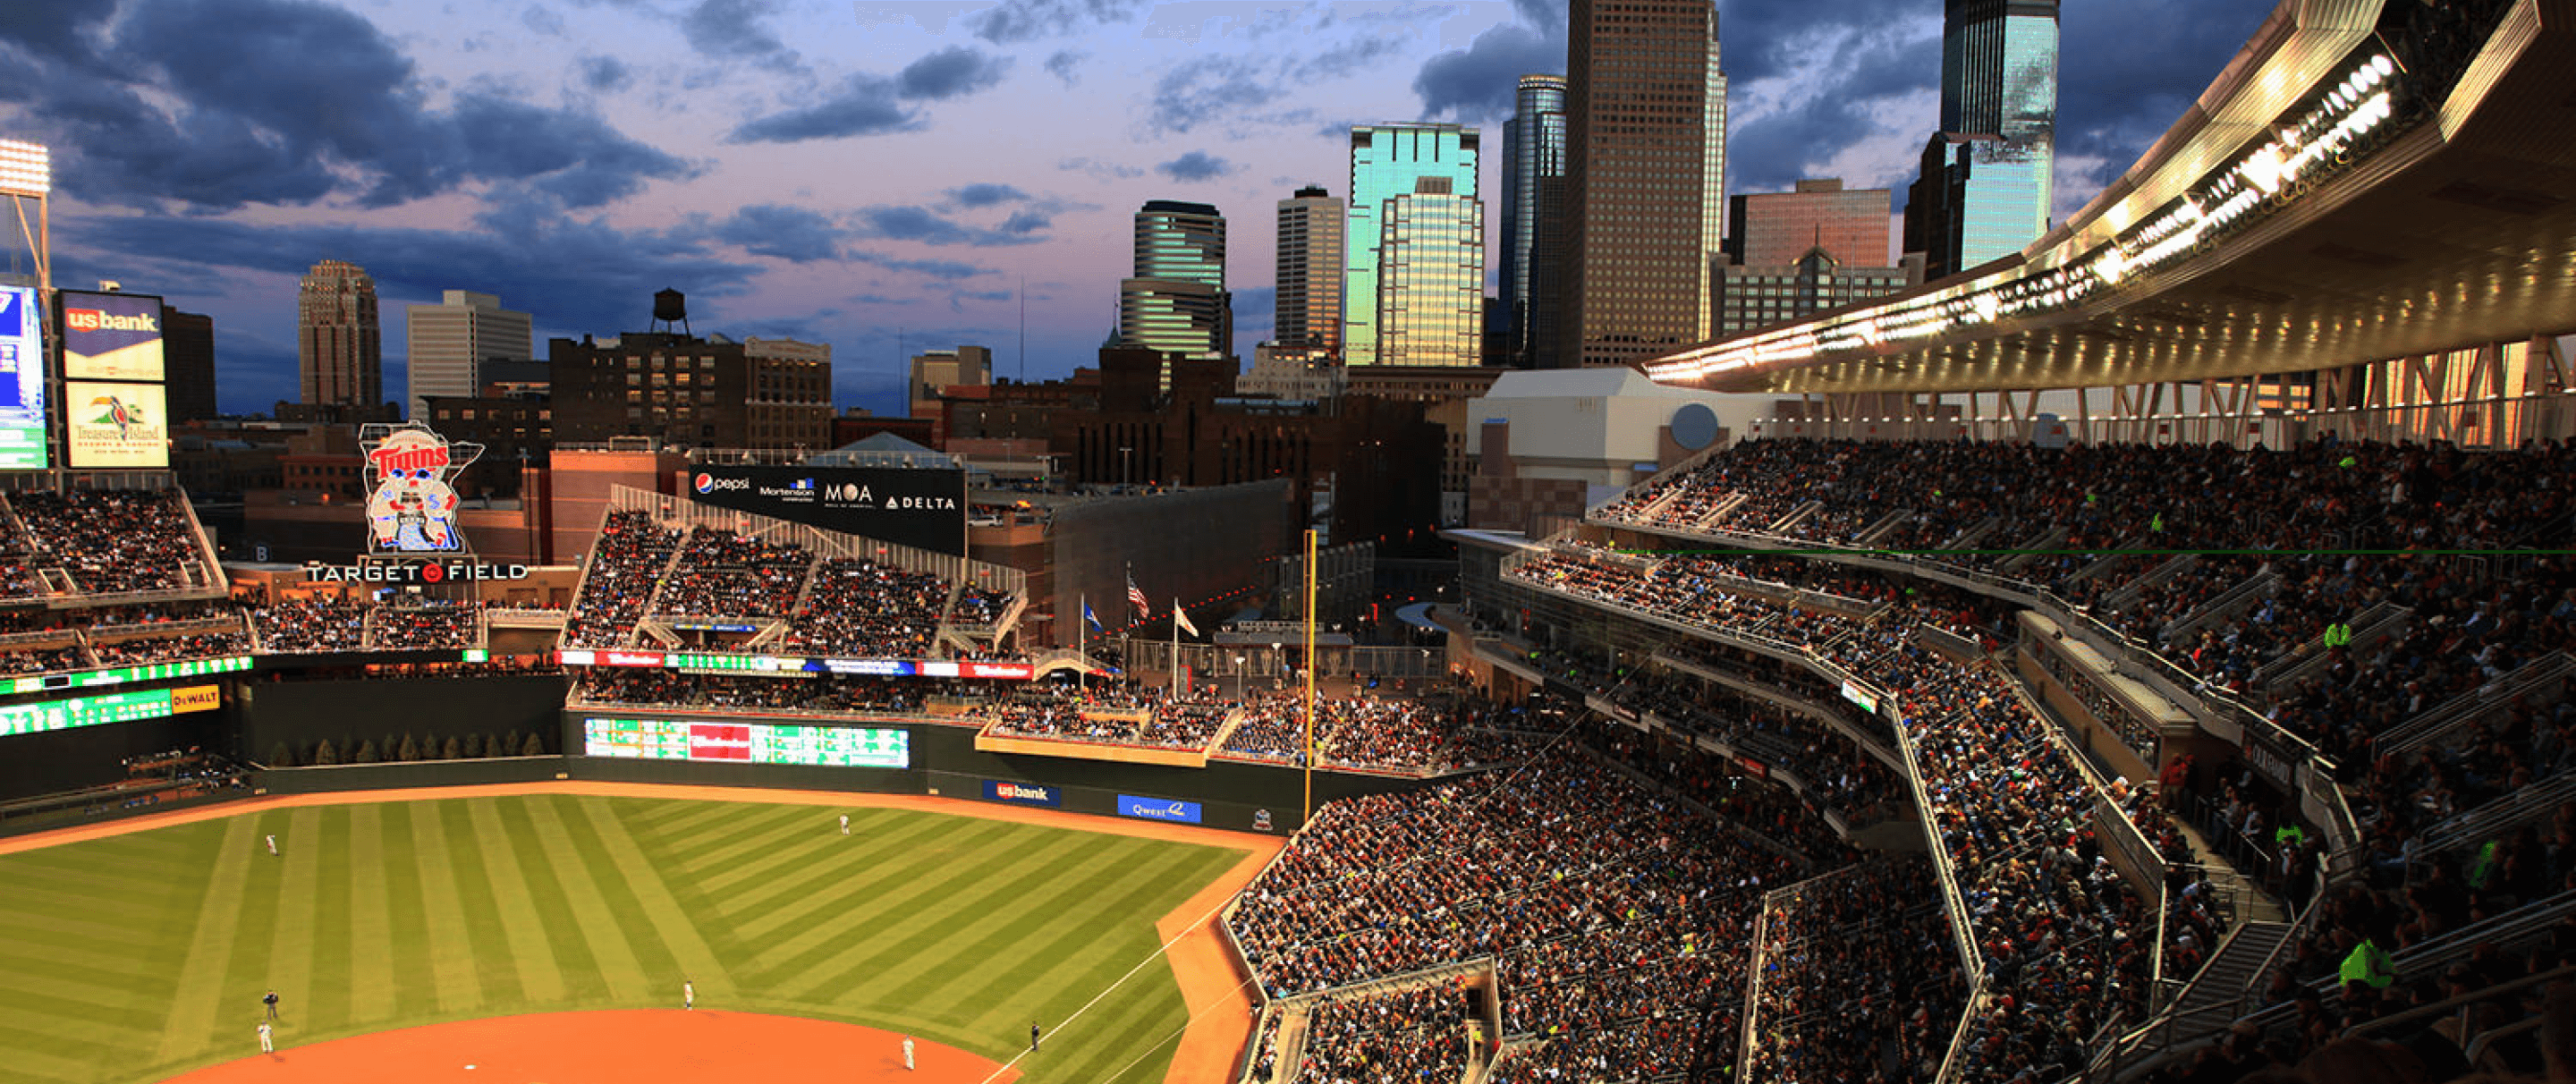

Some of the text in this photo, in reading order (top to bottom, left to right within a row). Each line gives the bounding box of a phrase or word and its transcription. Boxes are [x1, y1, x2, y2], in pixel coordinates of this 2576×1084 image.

[75, 424, 119, 440] Treasure
[369, 444, 449, 479] Twins
[715, 477, 750, 491] pepsi
[902, 496, 955, 510] DELTA
[257, 546, 267, 562] B
[307, 564, 528, 581] TARGET FIELD
